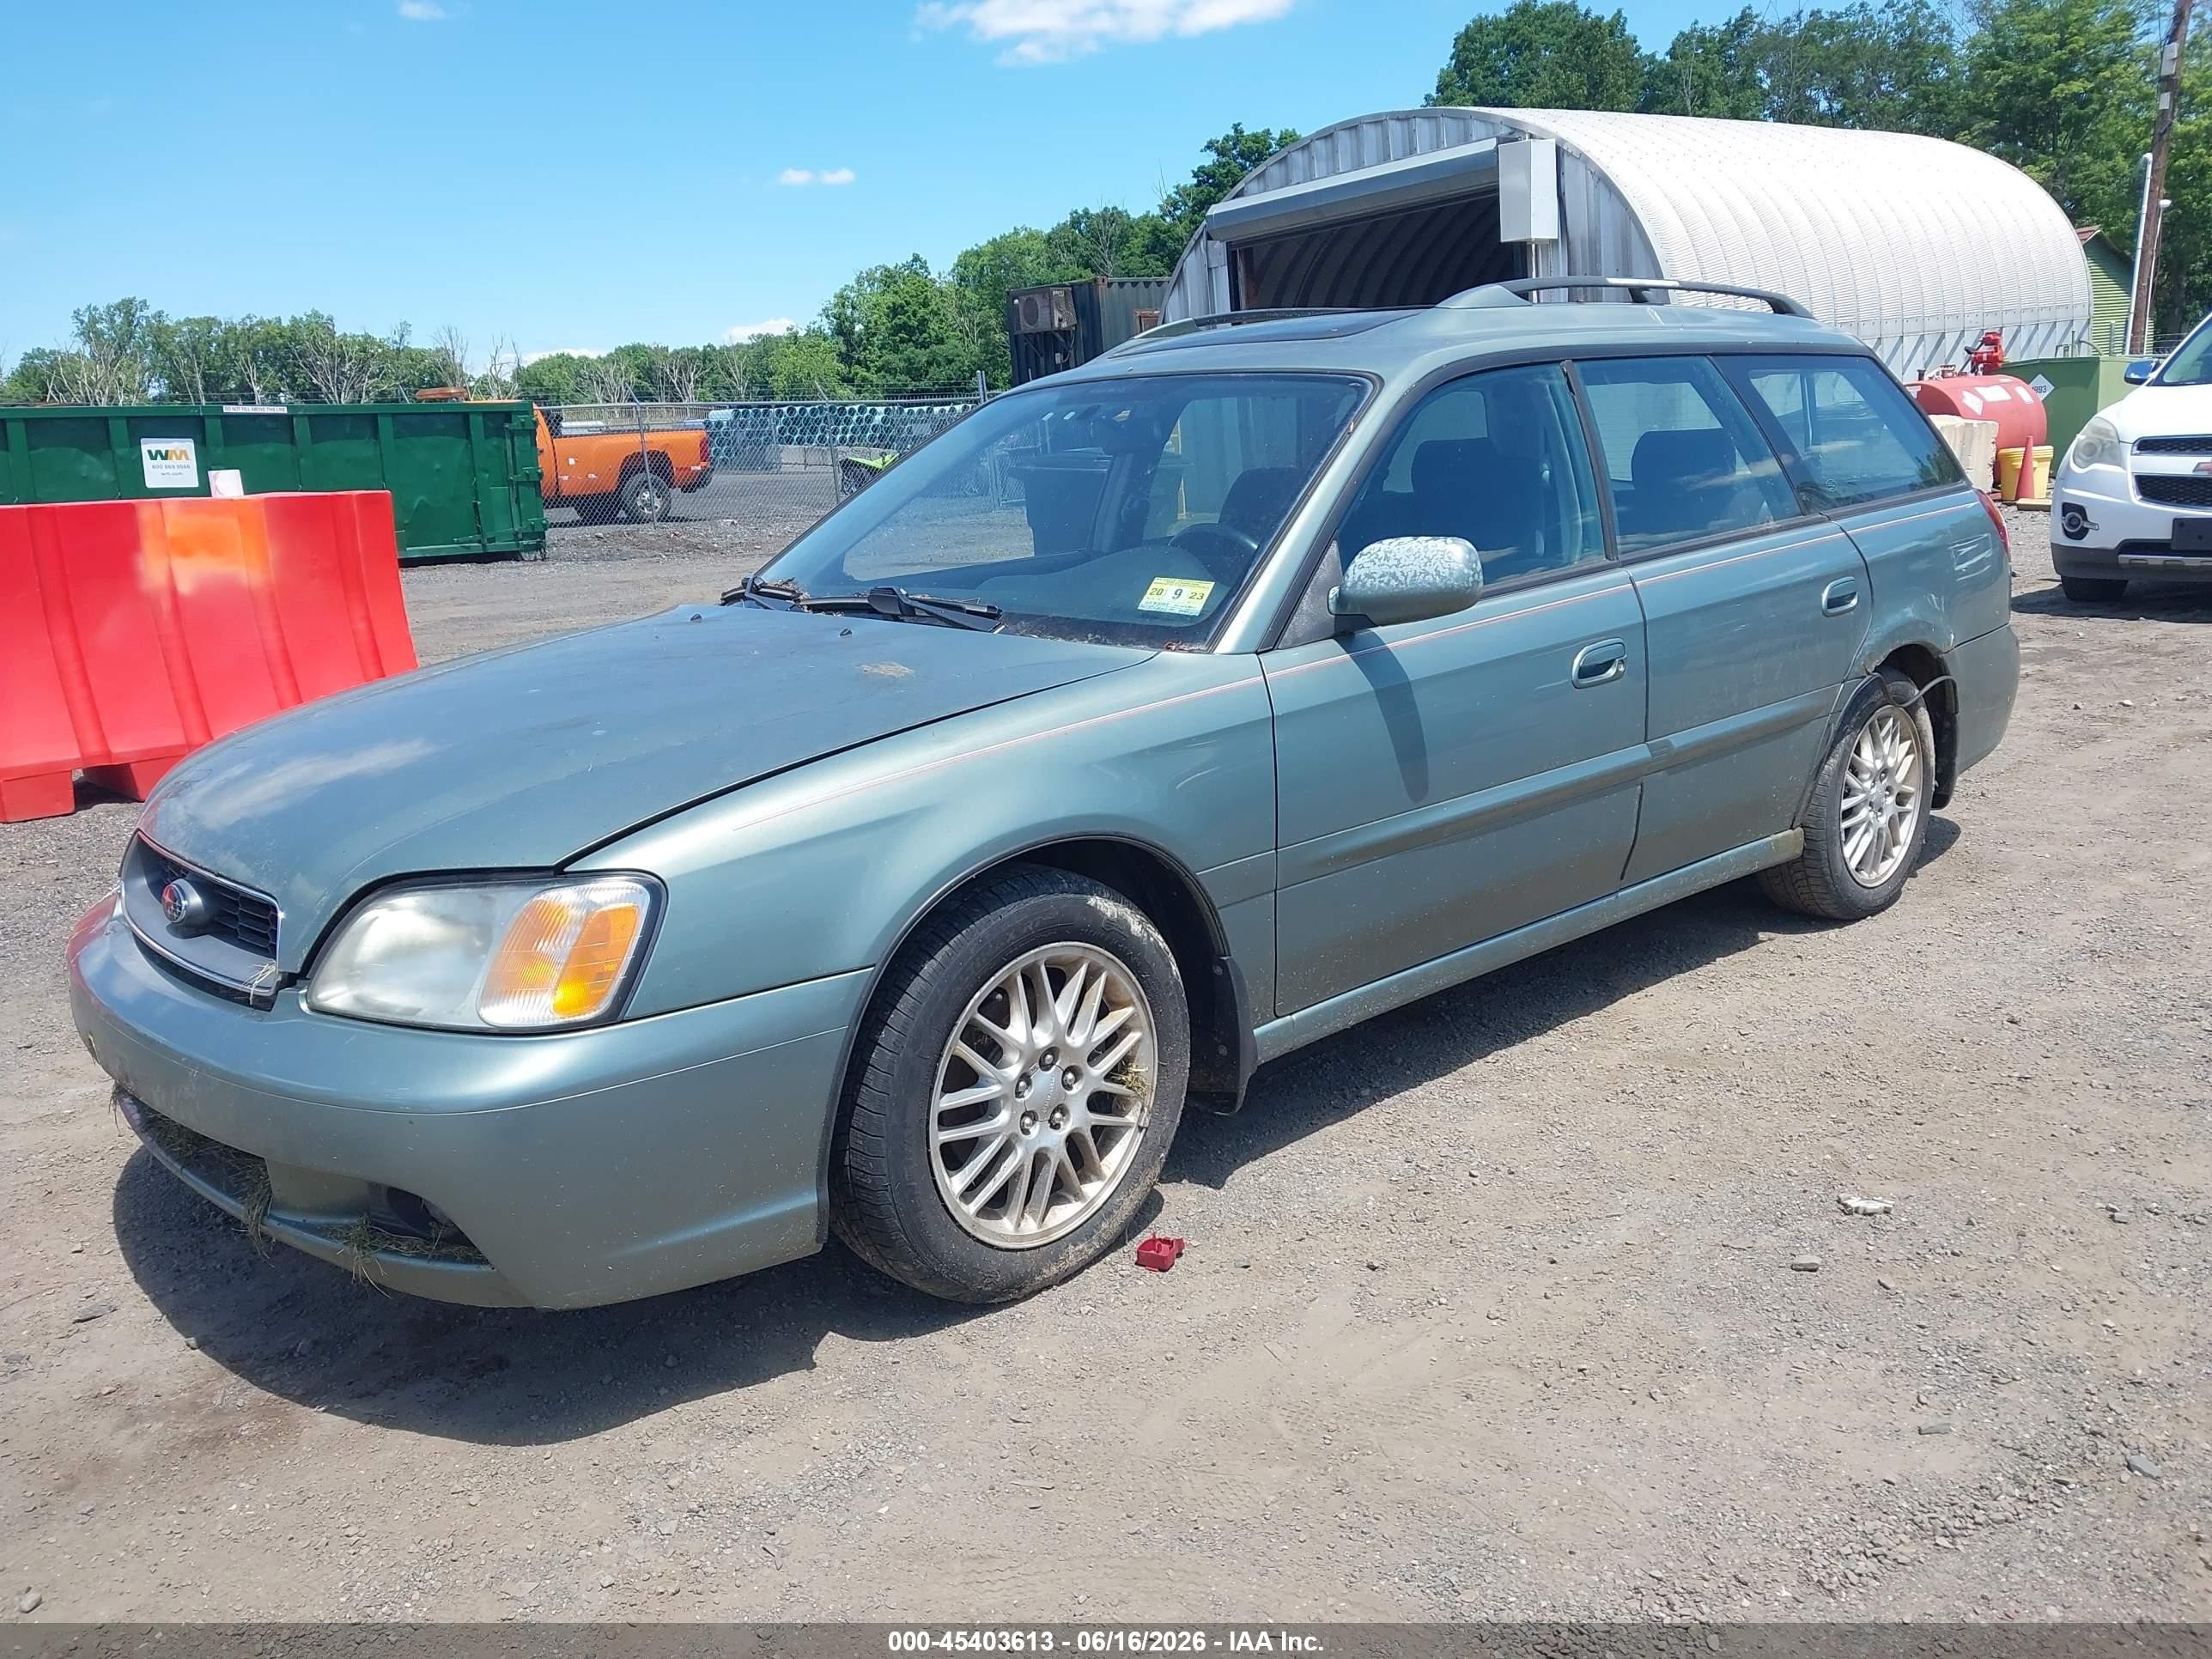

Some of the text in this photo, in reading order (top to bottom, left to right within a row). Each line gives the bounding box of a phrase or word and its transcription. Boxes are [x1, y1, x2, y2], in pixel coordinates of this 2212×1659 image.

[147, 449, 190, 461] WM
[1149, 587, 1164, 596] 20
[1171, 588, 1183, 599] 9
[1188, 592, 1205, 600] 23
